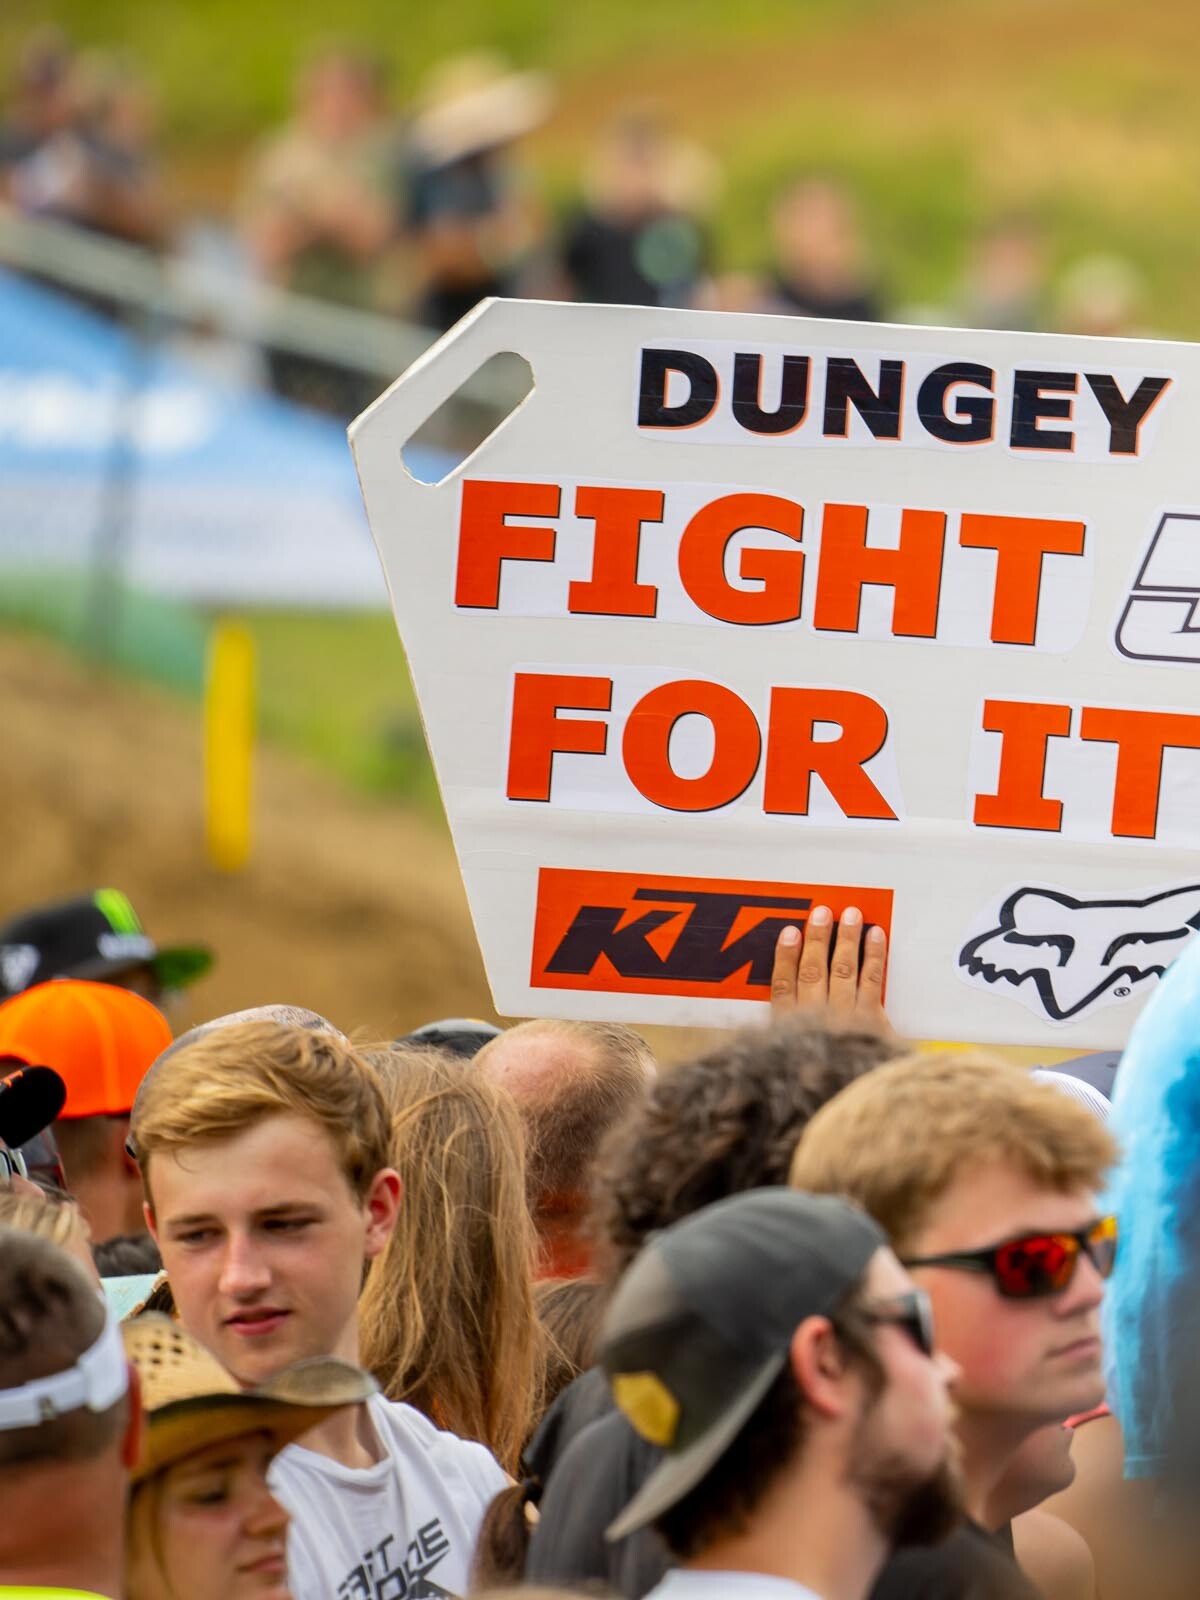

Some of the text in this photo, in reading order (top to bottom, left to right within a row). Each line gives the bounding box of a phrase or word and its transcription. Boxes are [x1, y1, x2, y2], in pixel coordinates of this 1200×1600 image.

[637, 347, 1174, 456] DUNGEY
[453, 479, 1087, 647] FIGHT
[505, 672, 901, 822] FOR
